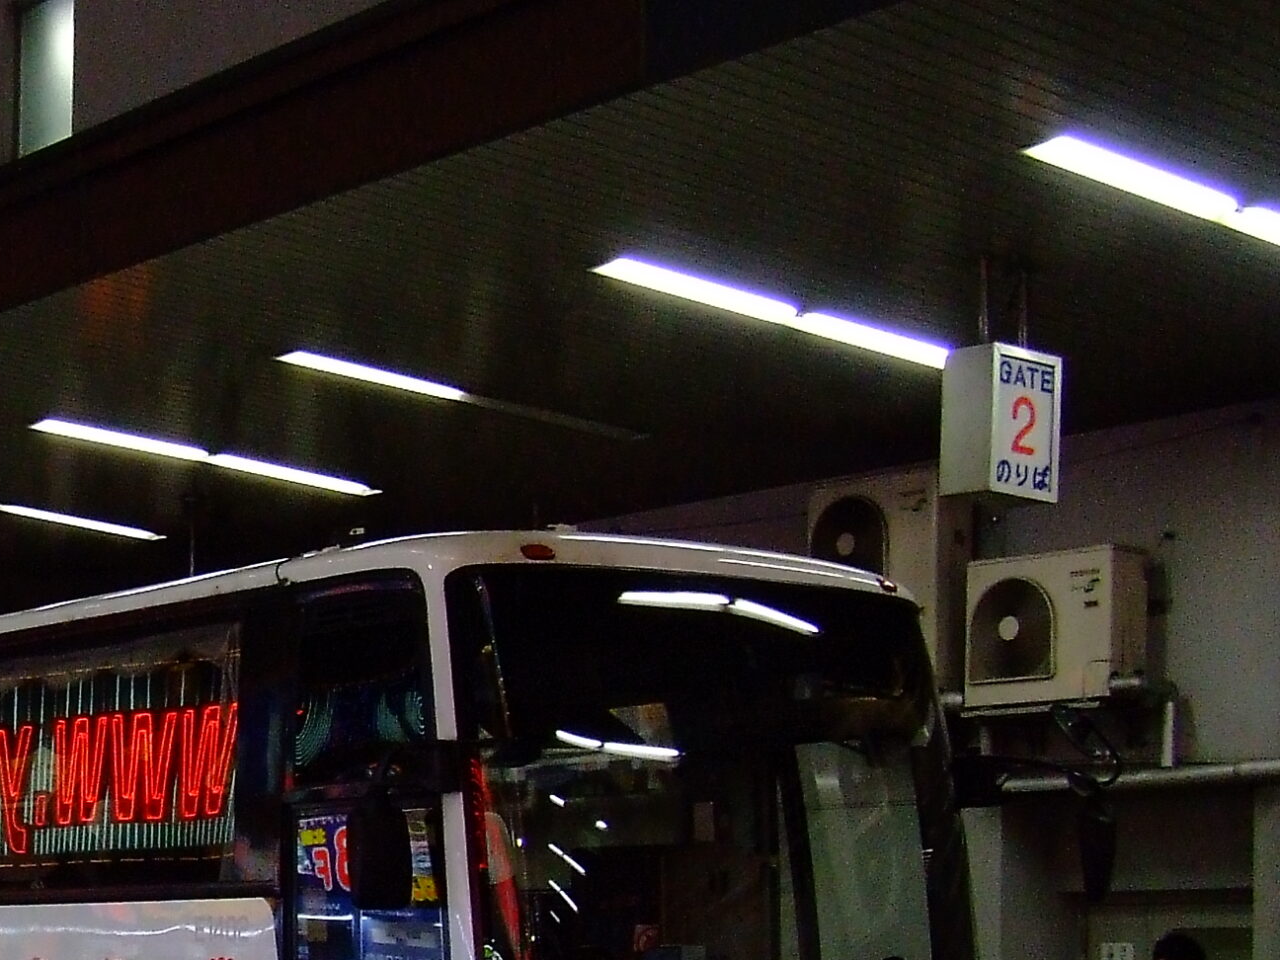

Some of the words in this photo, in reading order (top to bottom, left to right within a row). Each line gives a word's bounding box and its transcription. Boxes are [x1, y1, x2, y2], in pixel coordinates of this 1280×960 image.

[1000, 360, 1054, 394] GATE
[1011, 396, 1036, 456] 2
[996, 459, 1051, 491] のりば
